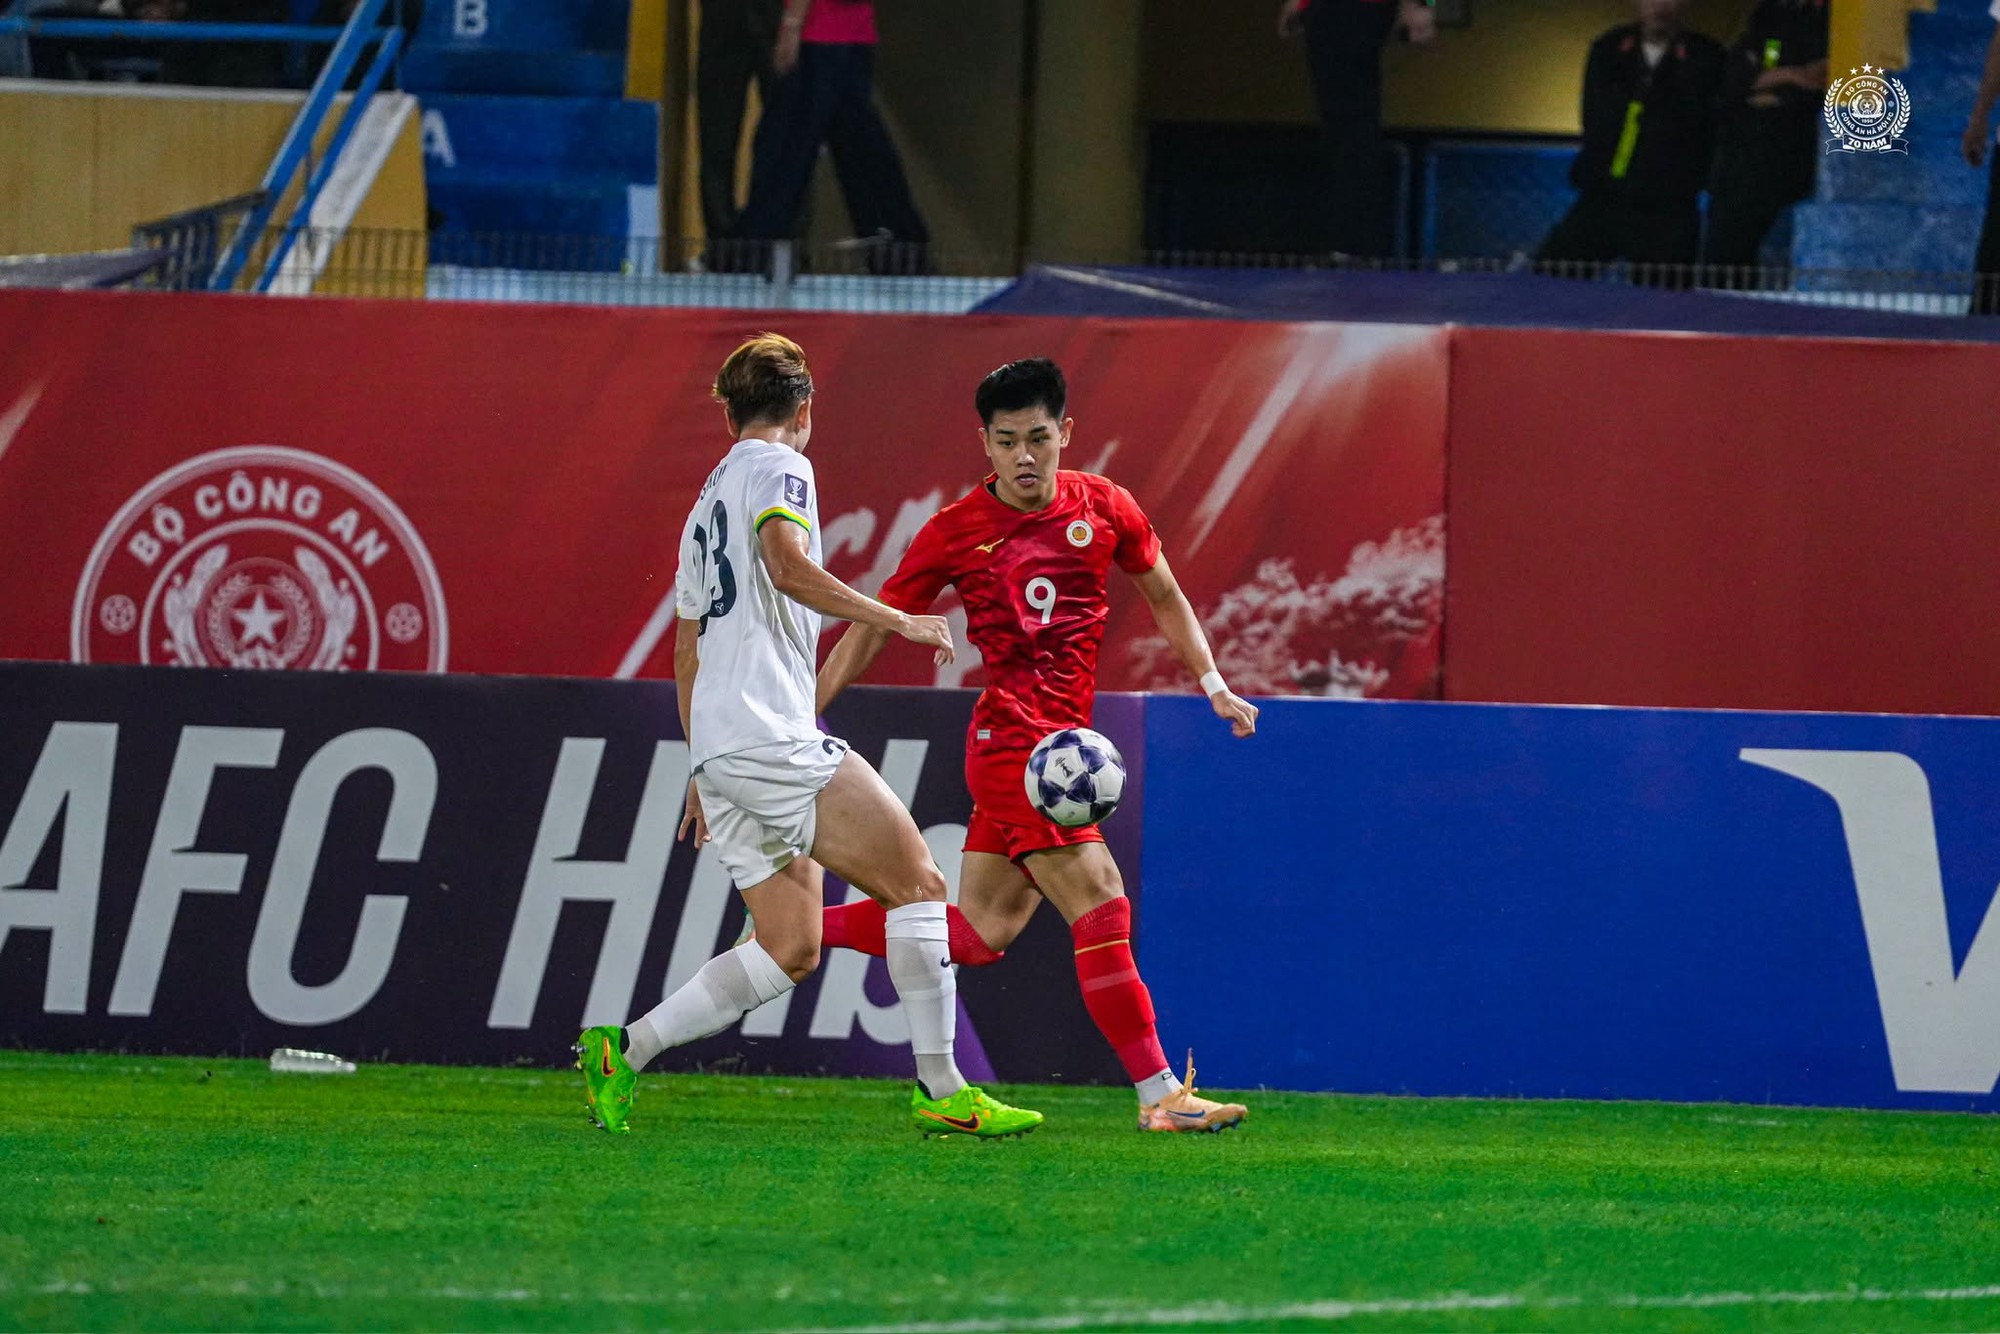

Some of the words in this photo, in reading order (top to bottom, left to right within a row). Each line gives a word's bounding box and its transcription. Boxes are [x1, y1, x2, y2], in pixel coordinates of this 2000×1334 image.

[455, 0, 488, 35] B
[128, 503, 186, 566] BỘ
[194, 470, 323, 519] CÔNG
[328, 508, 390, 567] AN
[1025, 577, 1057, 624] 9
[0, 721, 439, 1027] AFC
